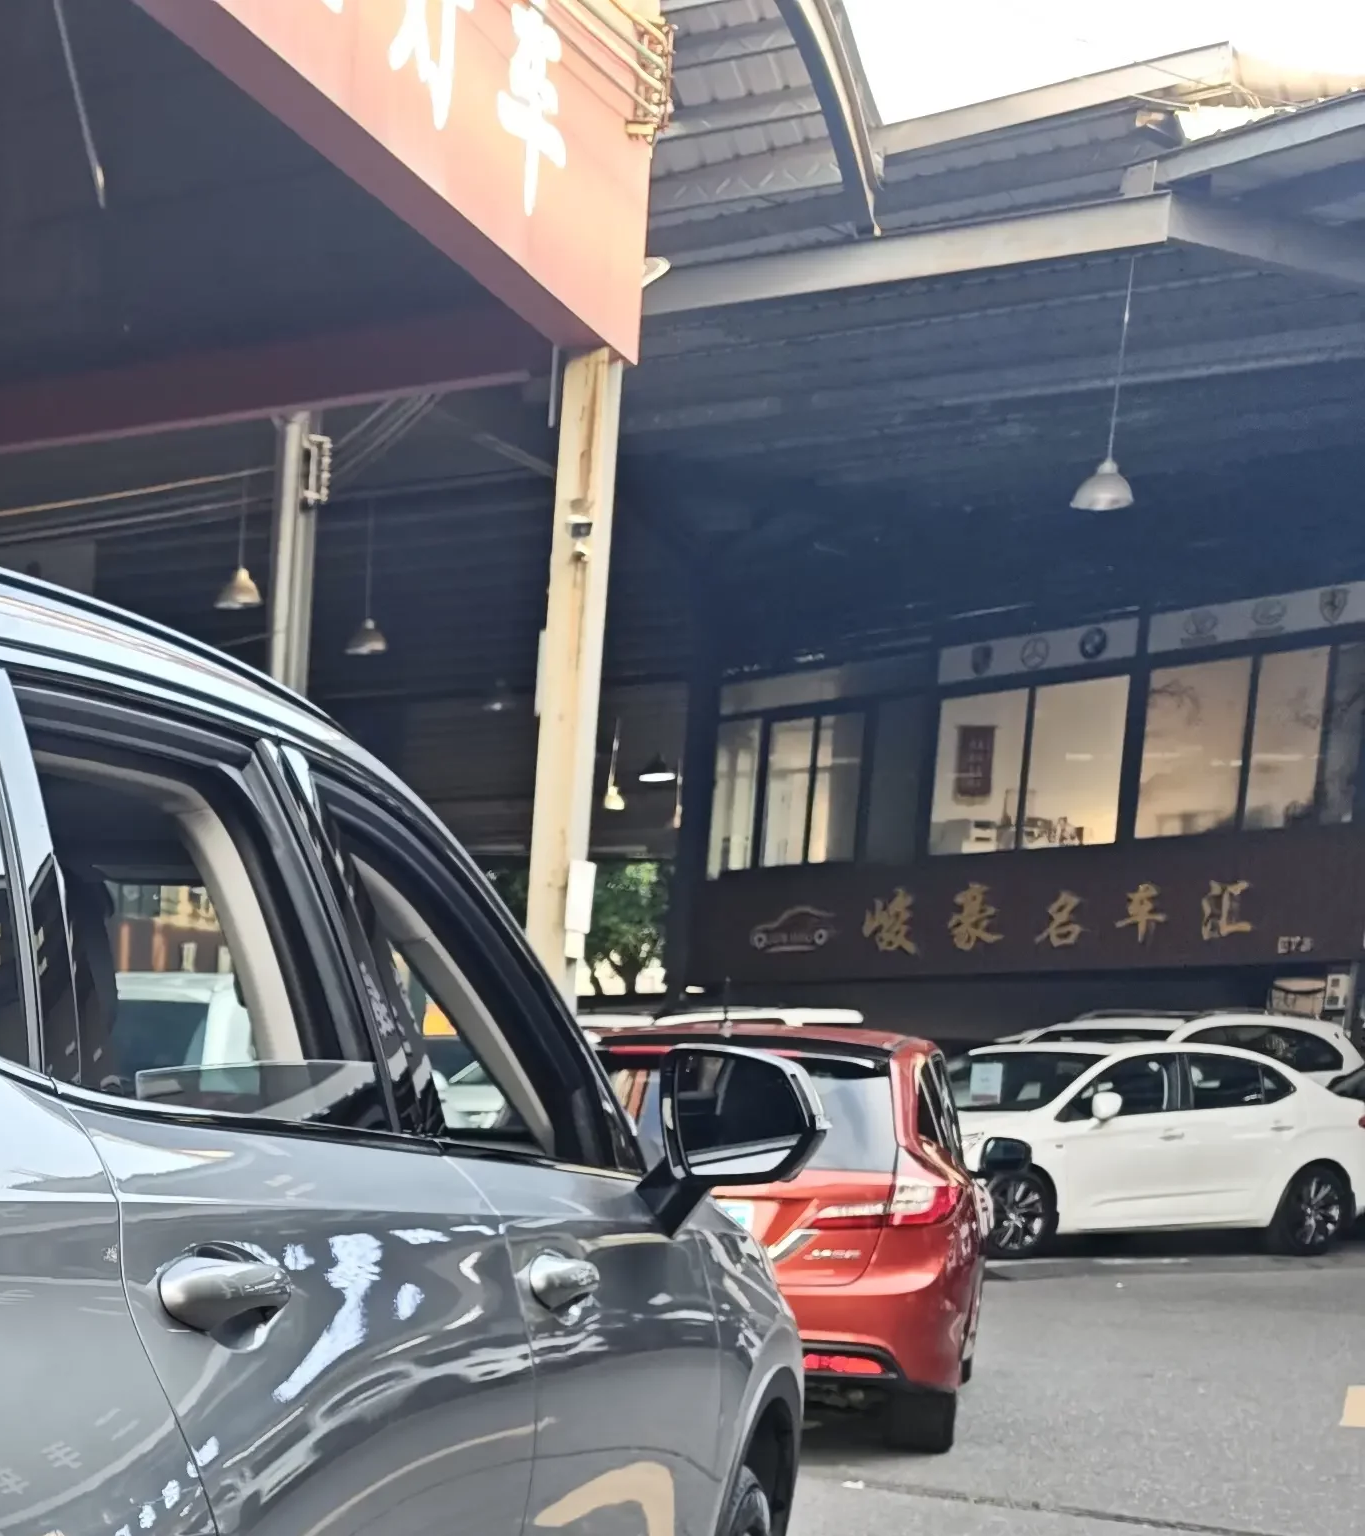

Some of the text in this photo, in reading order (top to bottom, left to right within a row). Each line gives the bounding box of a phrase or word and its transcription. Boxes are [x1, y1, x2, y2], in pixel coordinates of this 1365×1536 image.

[861, 879, 1255, 957] 峻豪名车汇
